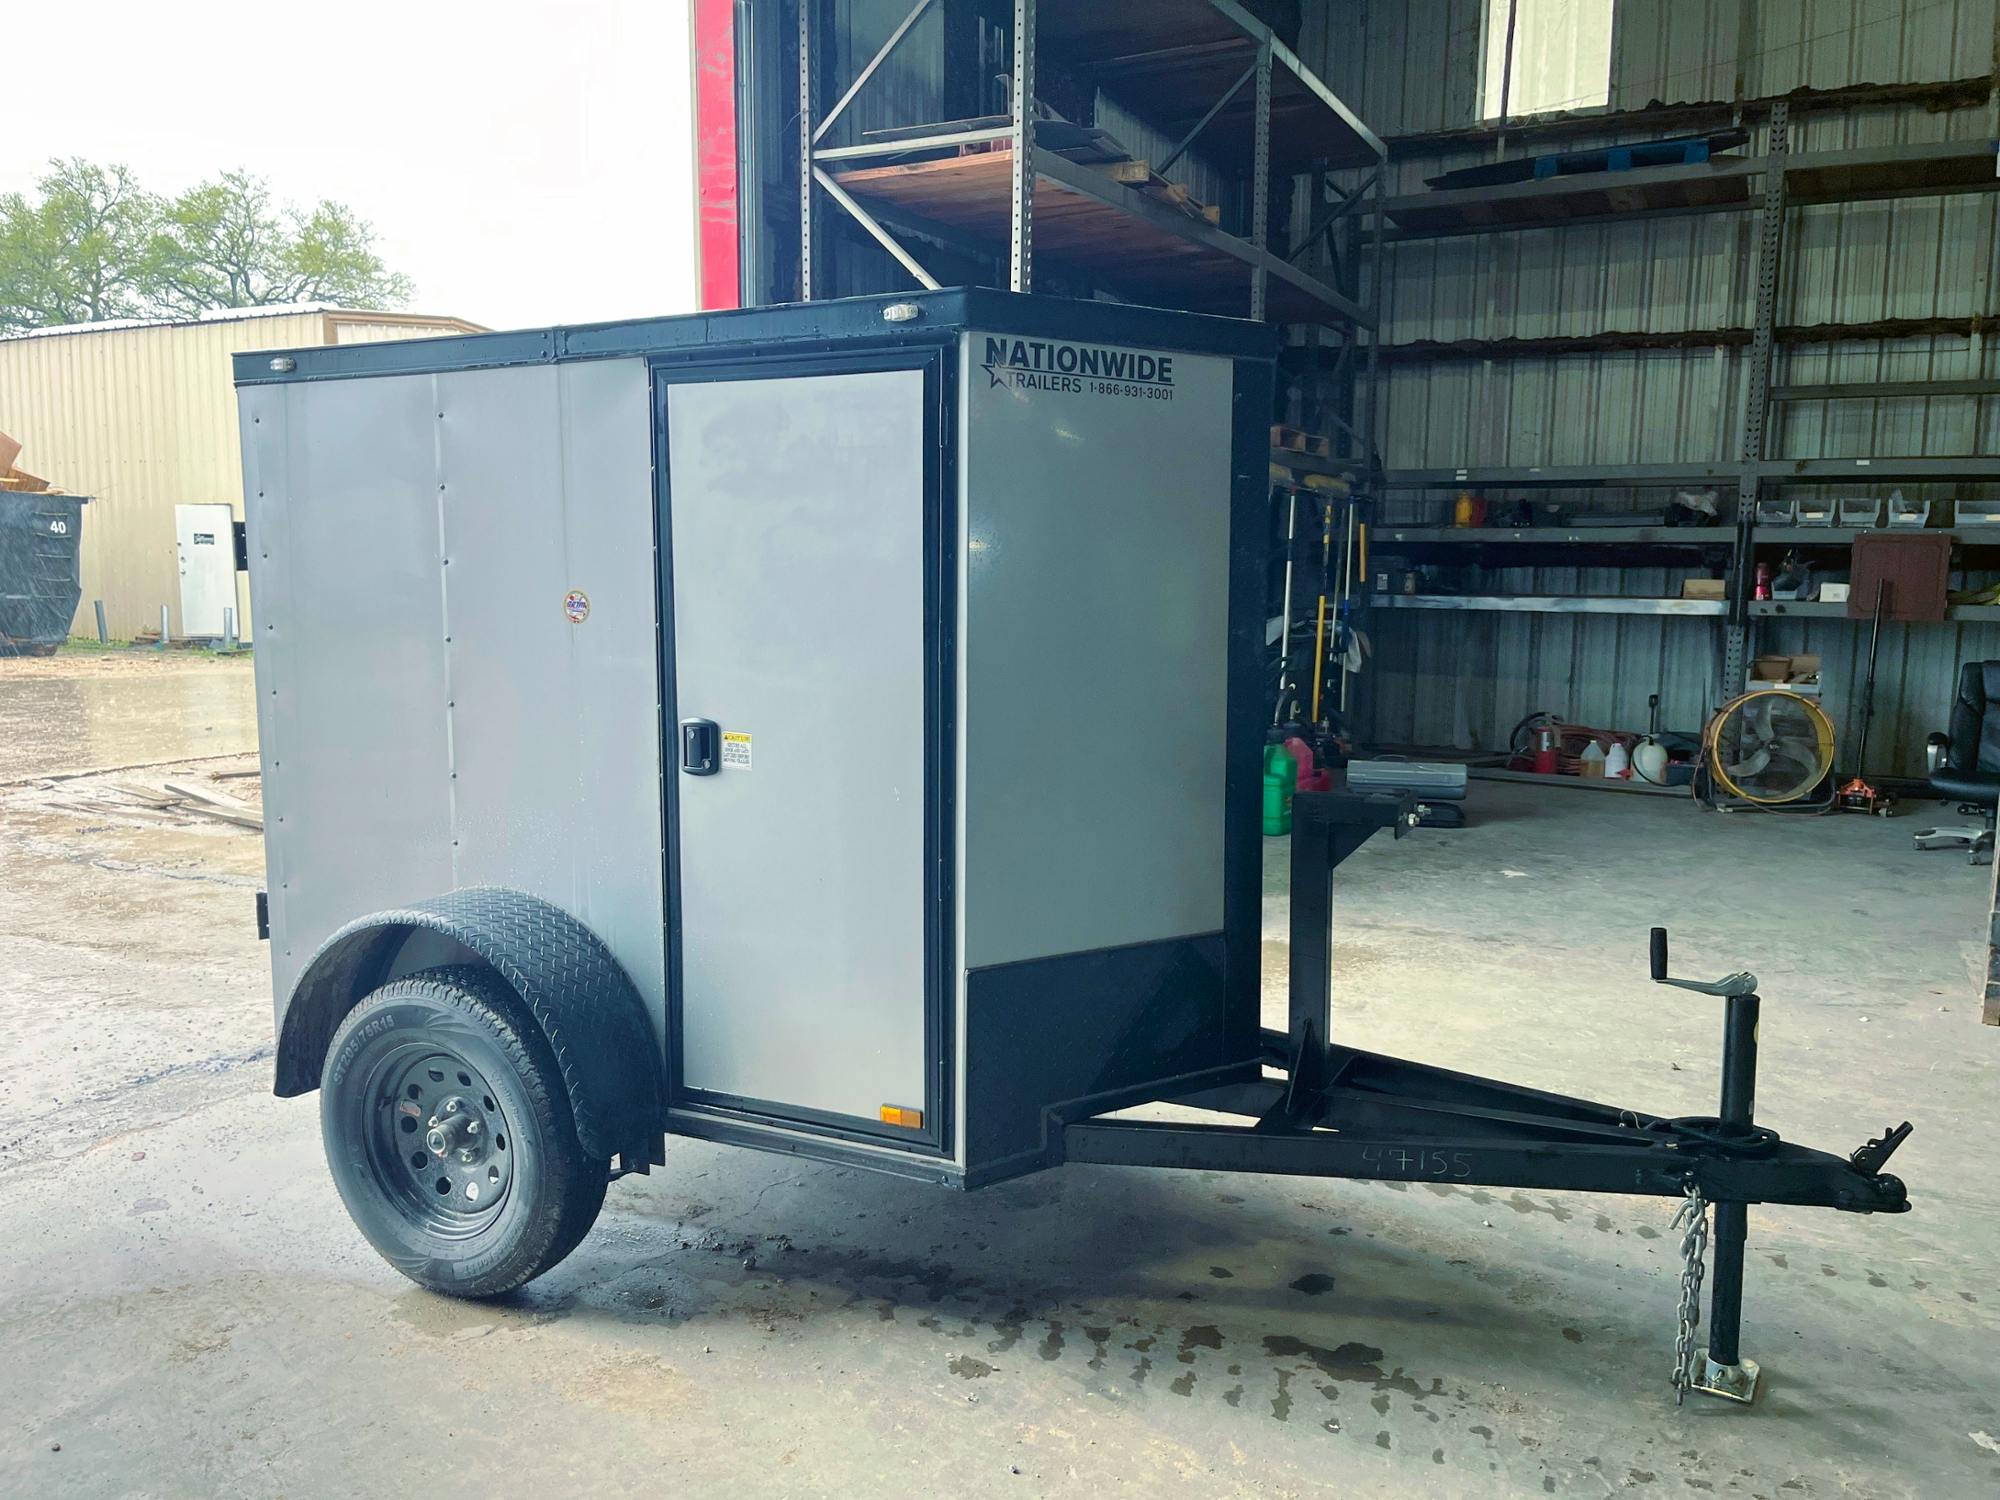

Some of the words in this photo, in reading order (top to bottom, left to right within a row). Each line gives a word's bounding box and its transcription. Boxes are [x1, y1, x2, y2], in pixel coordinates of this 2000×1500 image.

[986, 337, 1173, 383] NATIONWIDE
[1007, 371, 1082, 394] TRAILERS
[1089, 381, 1173, 401] 1-866-931-3001
[50, 520, 67, 534] 40
[333, 1014, 395, 1086] ST205/75R15
[1362, 1145, 1473, 1178] 47155
